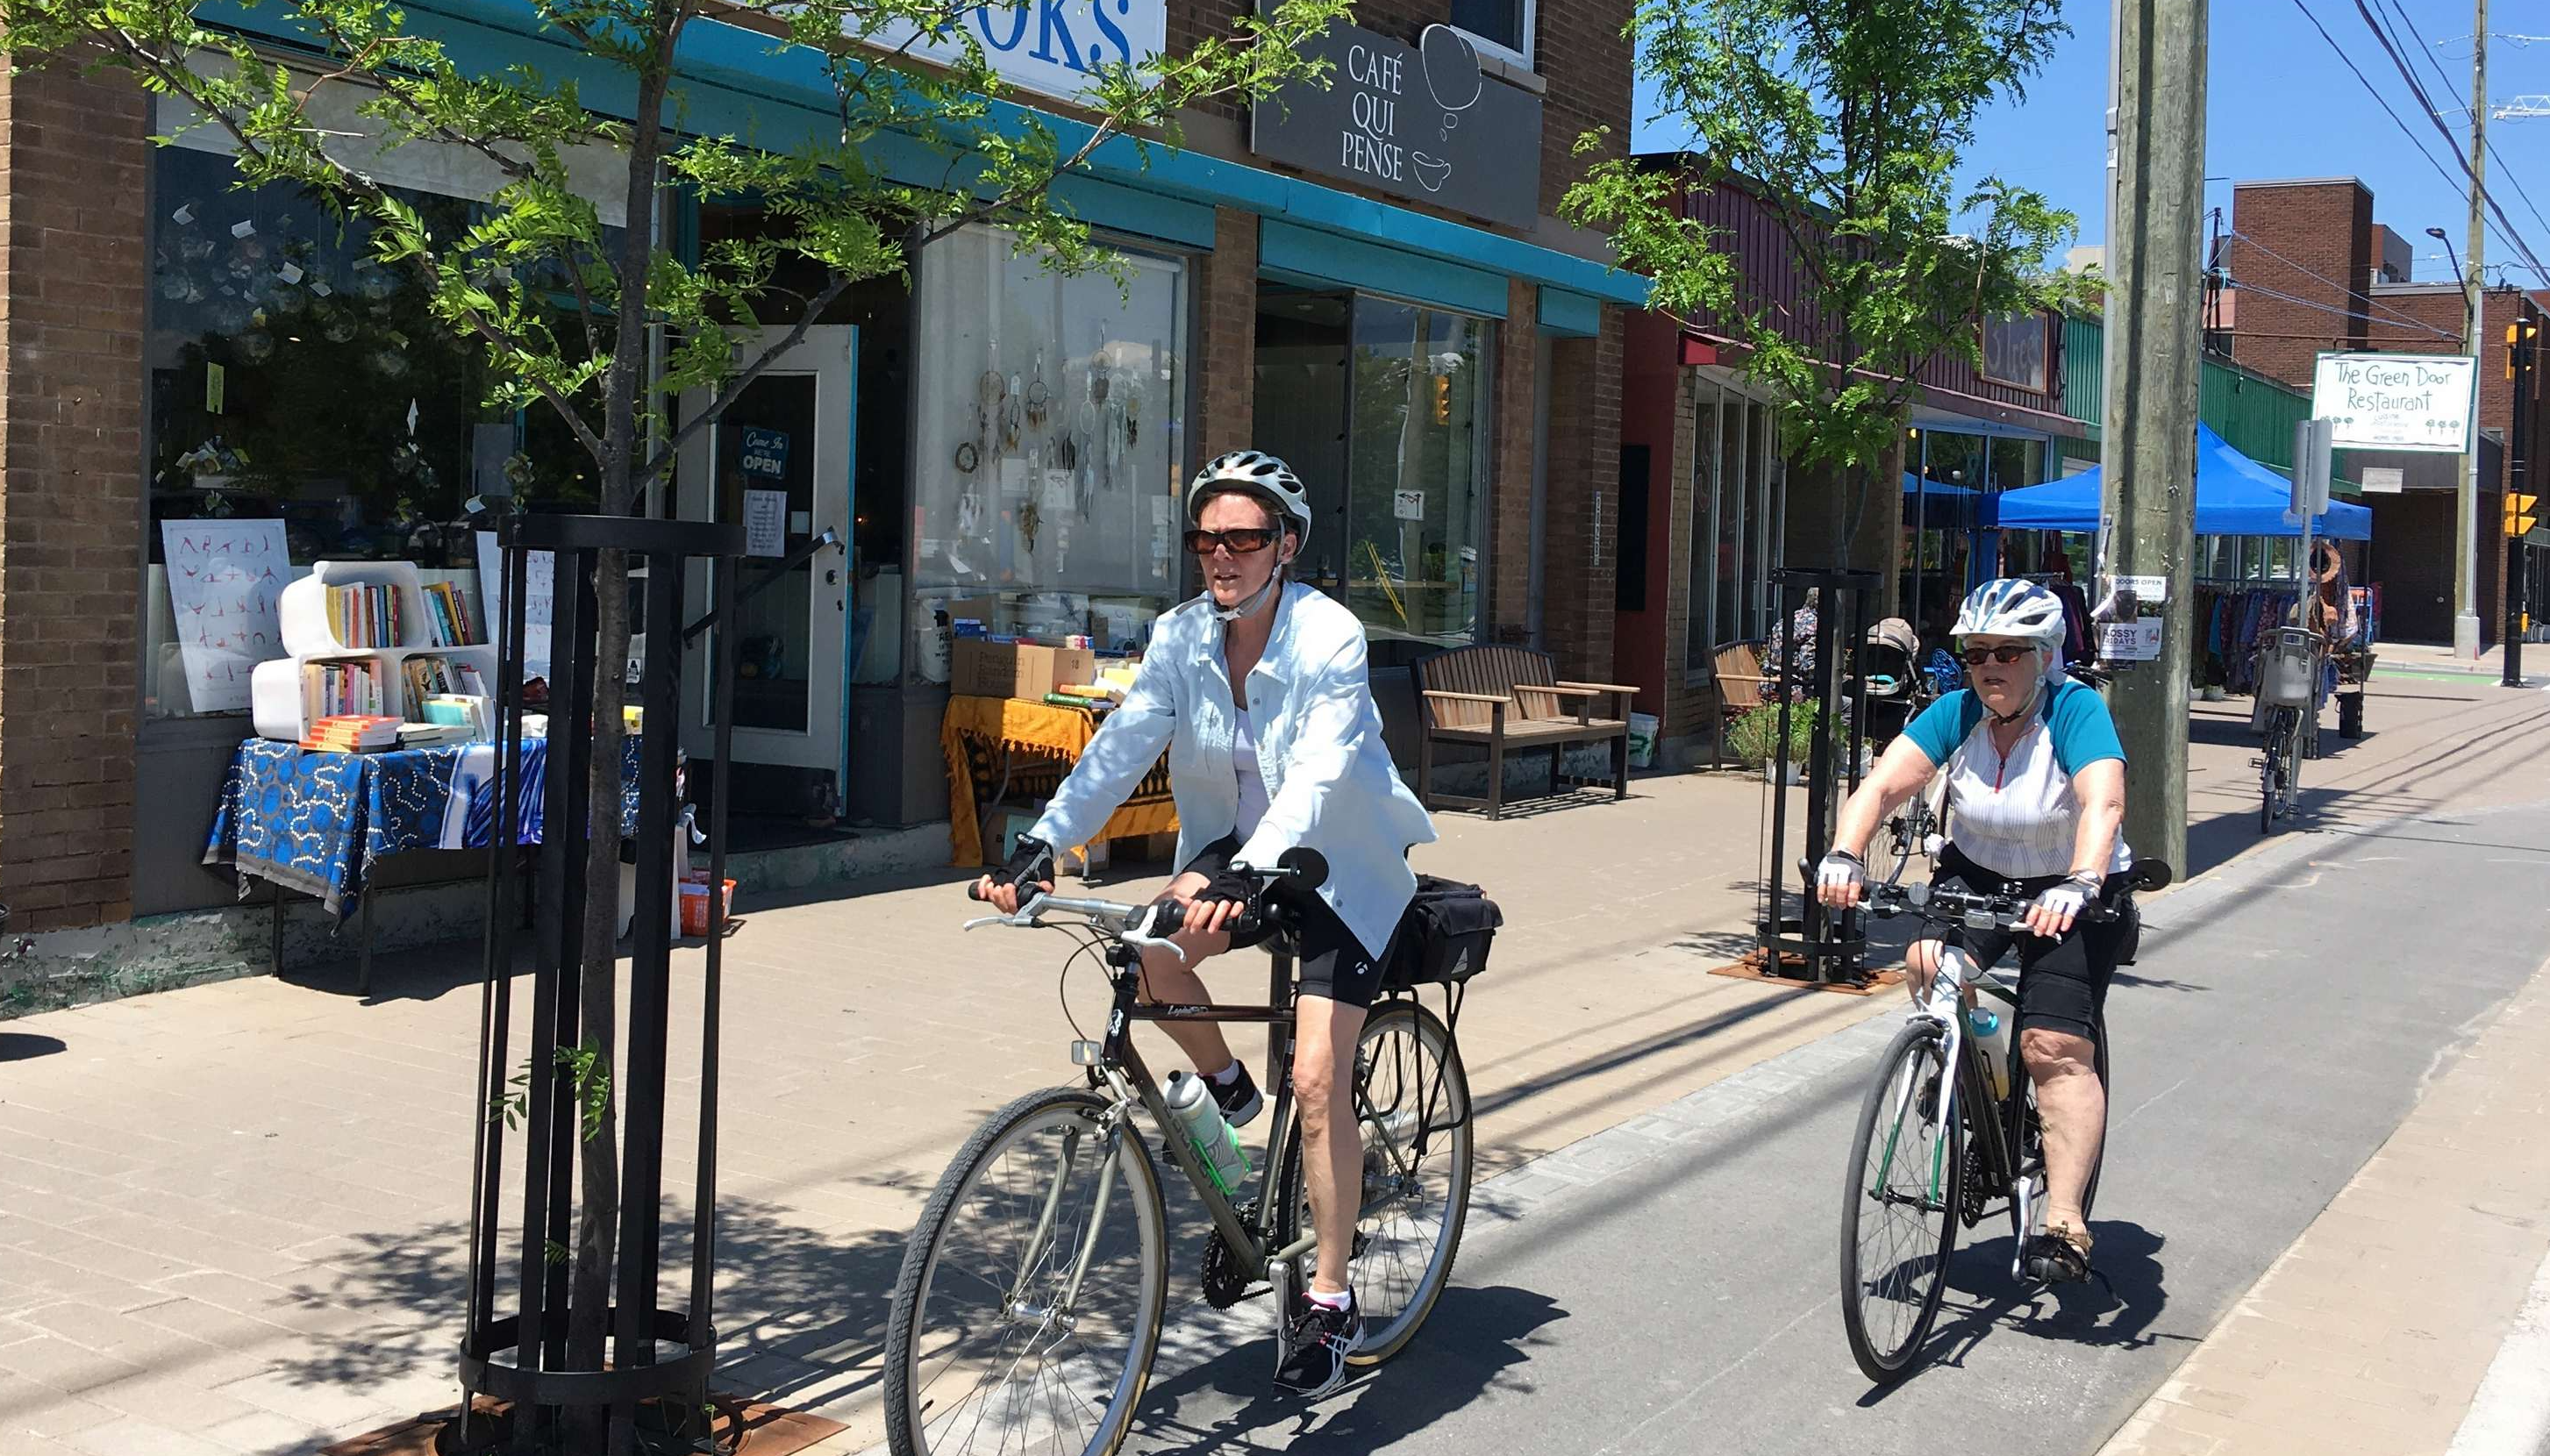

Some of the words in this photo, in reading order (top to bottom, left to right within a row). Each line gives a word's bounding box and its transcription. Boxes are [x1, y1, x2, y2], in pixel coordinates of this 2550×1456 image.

[1348, 45, 1403, 95] CAFÉ
[1353, 92, 1396, 140] QUI
[1341, 132, 1403, 182] PENSE
[2335, 362, 2360, 384] The
[2366, 365, 2410, 387] Green
[2415, 367, 2452, 386] Door
[2347, 387, 2432, 411] Restaurant
[746, 432, 769, 447] Come
[743, 455, 782, 474] OPEN
